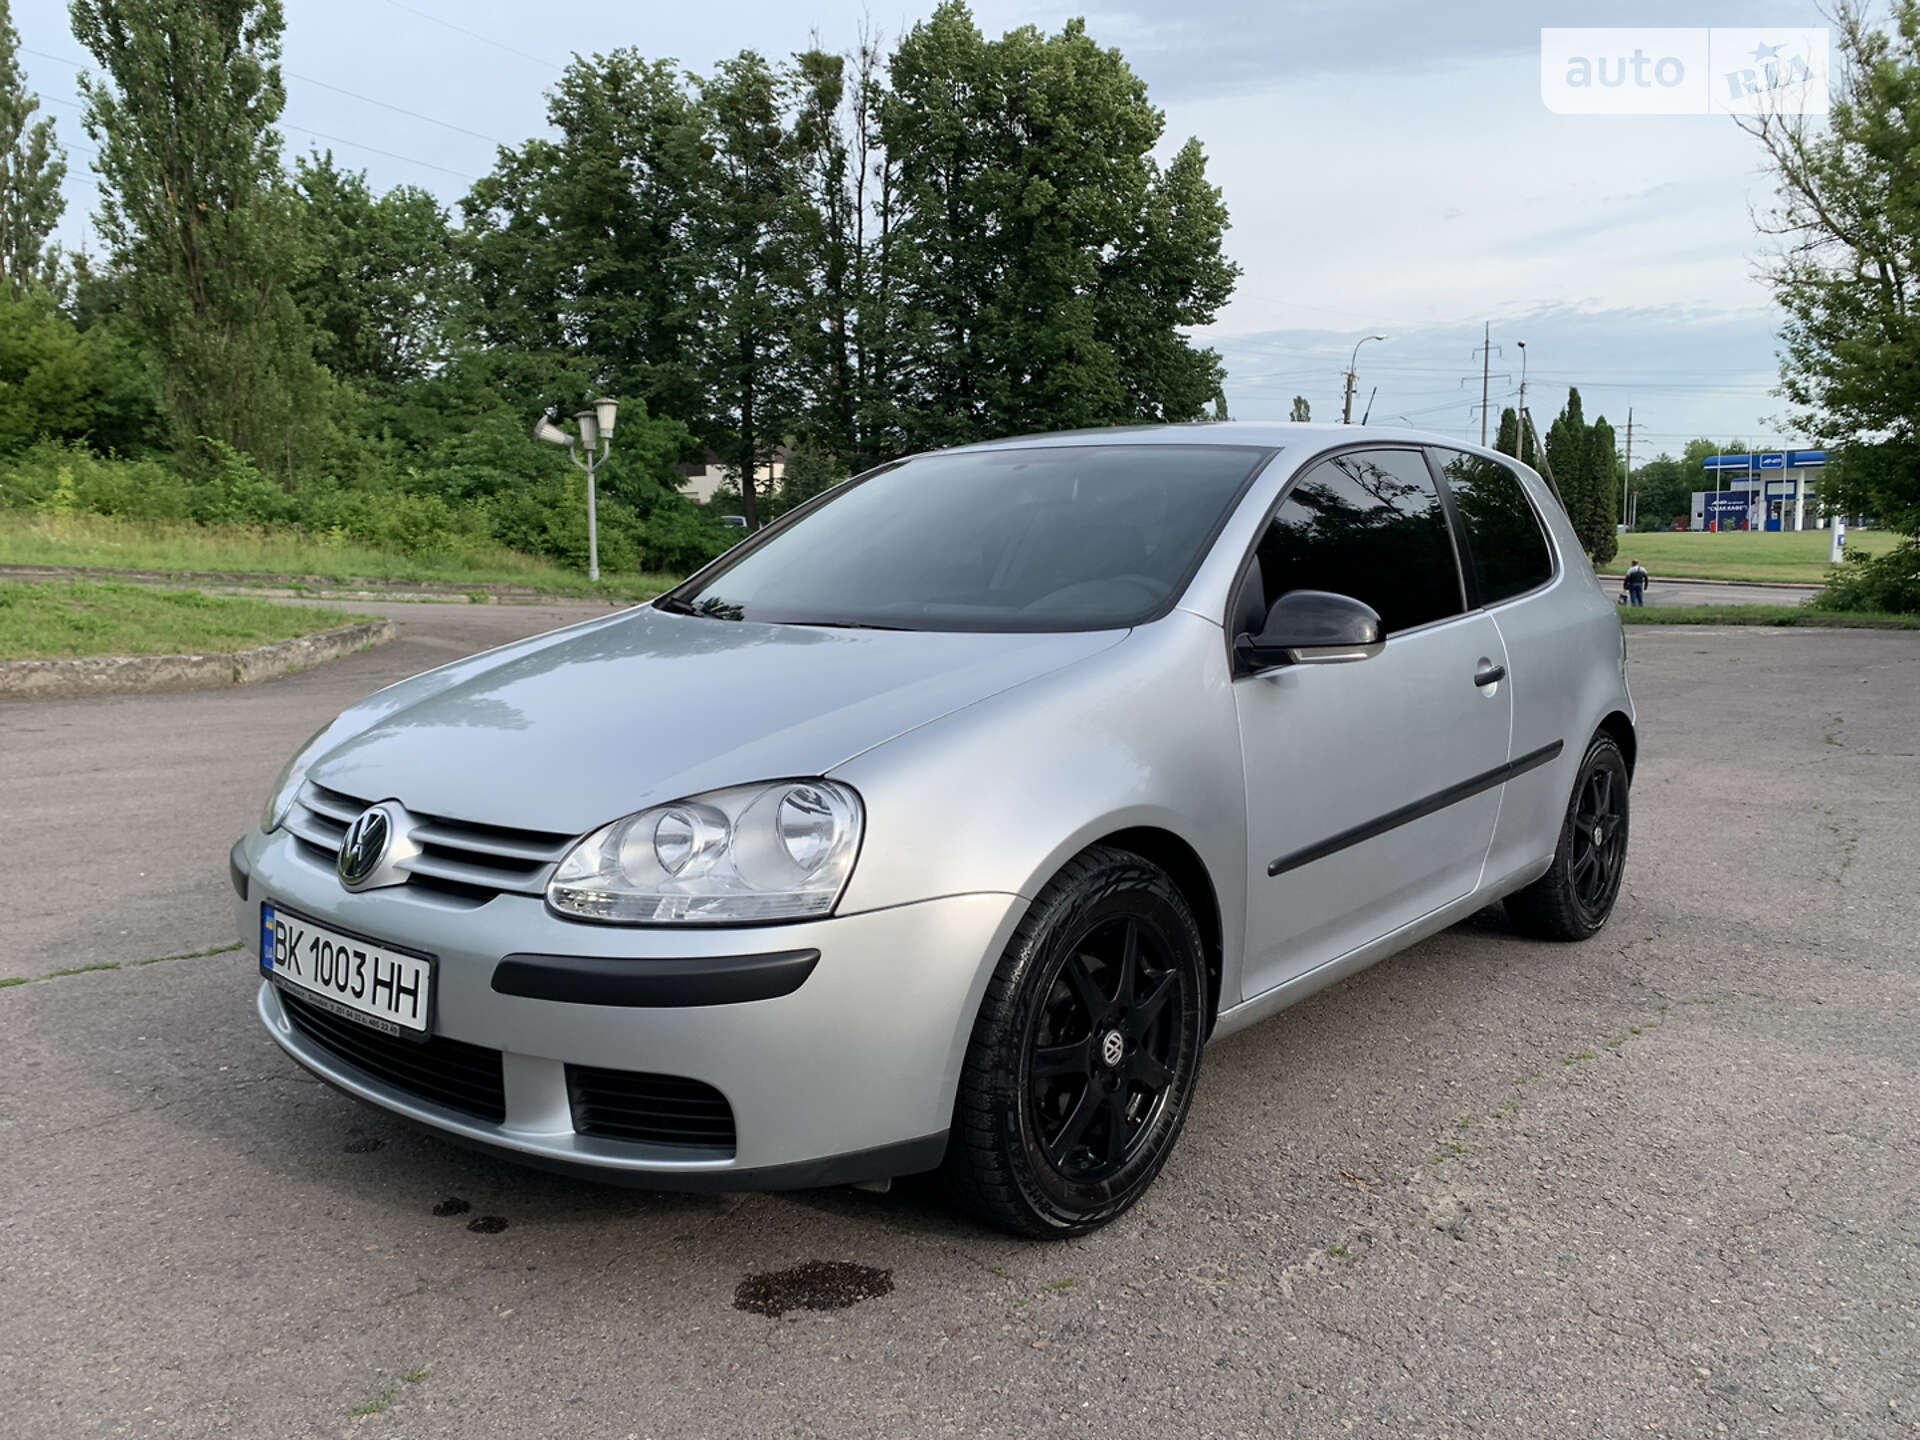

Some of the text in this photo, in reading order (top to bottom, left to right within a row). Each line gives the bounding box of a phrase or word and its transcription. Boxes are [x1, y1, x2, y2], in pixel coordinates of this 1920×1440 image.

[275, 919, 304, 976] BK
[309, 936, 367, 999] 1003
[372, 956, 420, 1019] HH
